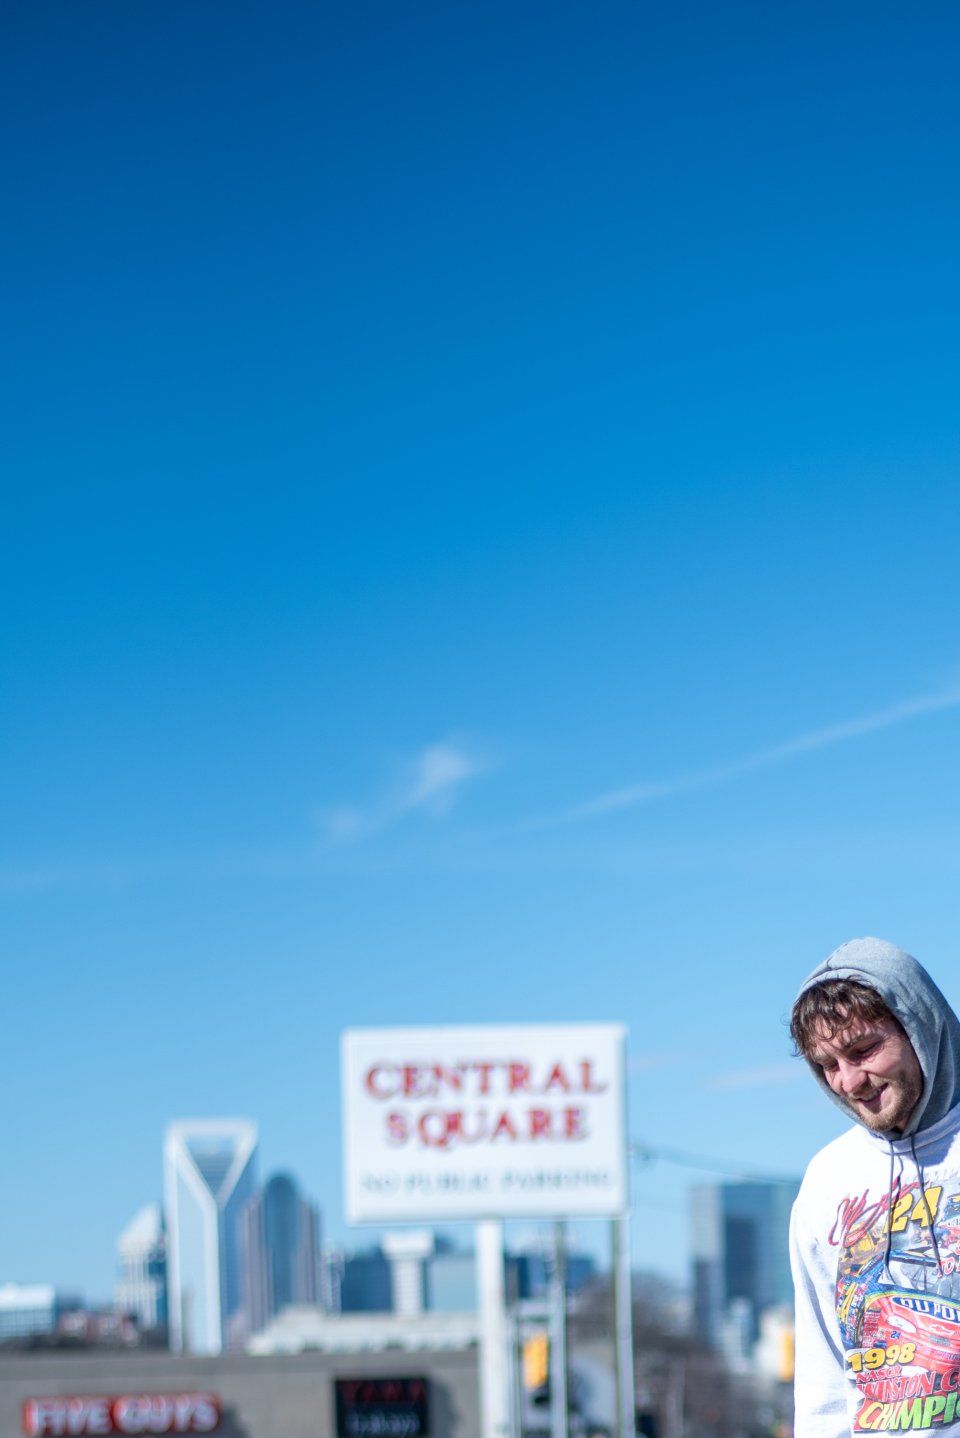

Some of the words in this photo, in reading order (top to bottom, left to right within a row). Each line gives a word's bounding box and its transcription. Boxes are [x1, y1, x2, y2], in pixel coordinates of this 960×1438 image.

[363, 1057, 611, 1100] CENTRAL
[386, 1104, 591, 1153] SQUARE
[884, 1186, 943, 1235] 24
[848, 1342, 917, 1373] 1998
[856, 1366, 902, 1383] NASCR
[856, 1370, 936, 1402] WINSTON
[30, 1396, 113, 1437] FIVE
[114, 1393, 219, 1434] GUYS
